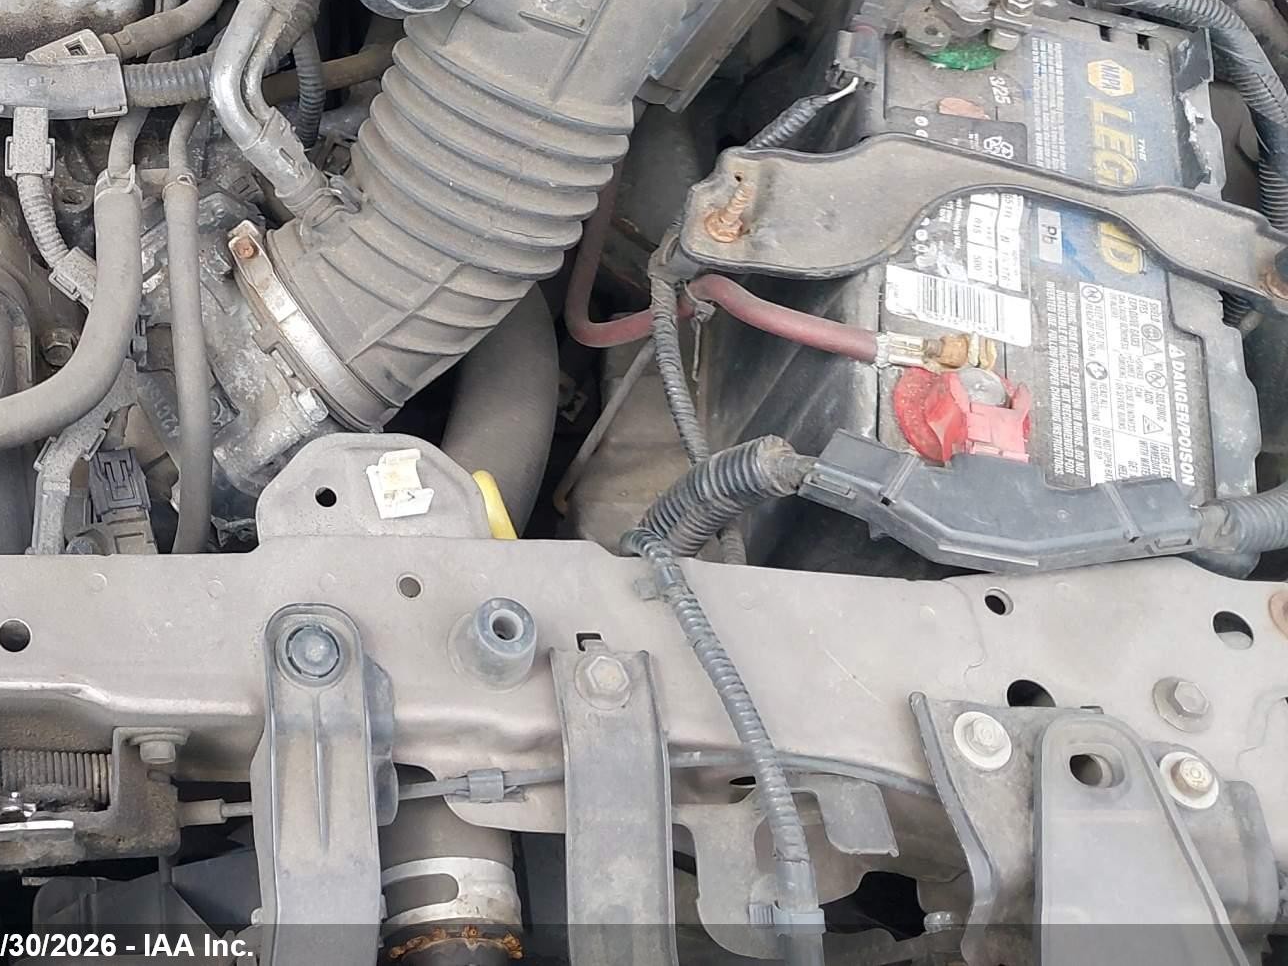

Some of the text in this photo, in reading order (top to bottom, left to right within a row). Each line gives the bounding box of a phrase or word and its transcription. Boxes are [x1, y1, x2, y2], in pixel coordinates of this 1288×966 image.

[989, 76, 1011, 104] 3/25
[1100, 63, 1121, 91] NAPA
[1042, 224, 1058, 244] Pb
[1172, 360, 1195, 487] DANGER/POISON
[1140, 458, 1150, 476] WATE
